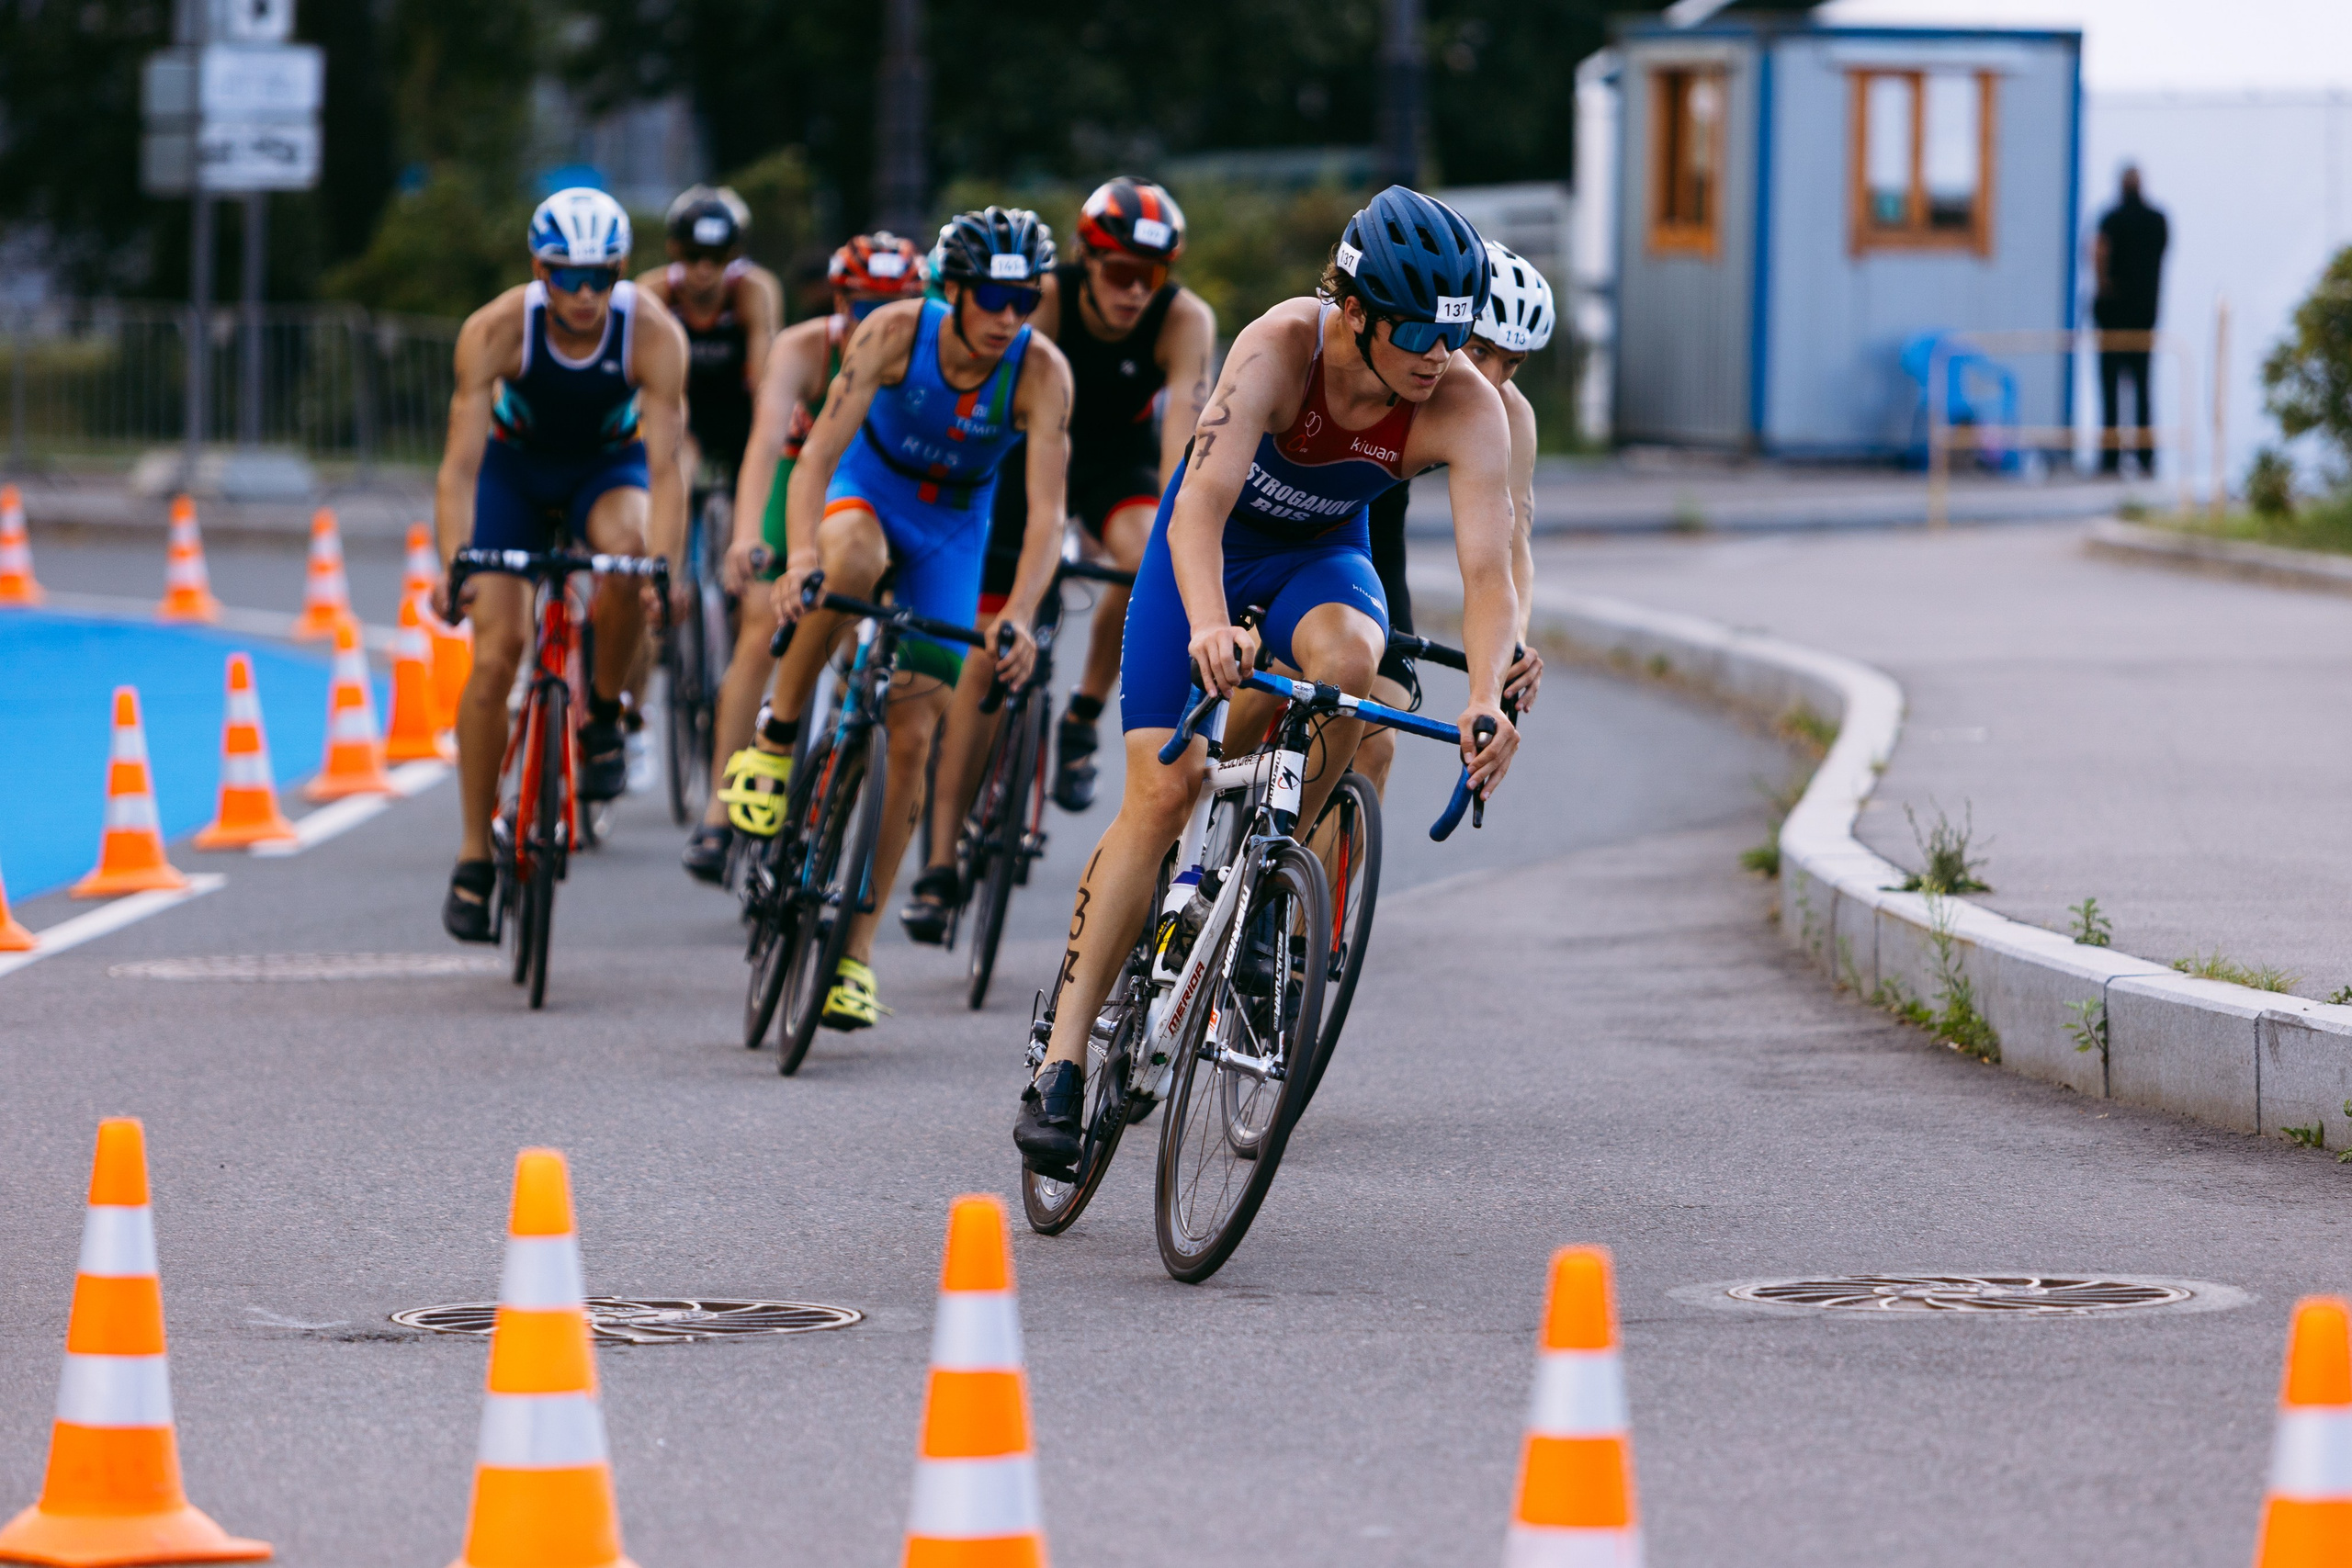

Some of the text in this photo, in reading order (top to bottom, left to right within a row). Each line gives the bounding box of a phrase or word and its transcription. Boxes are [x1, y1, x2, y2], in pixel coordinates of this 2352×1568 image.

[1340, 250, 1355, 268] 137
[1443, 302, 1468, 318] 137
[1246, 461, 1361, 516] STROGANOV
[1250, 497, 1311, 521] RUS
[1221, 884, 1251, 980] MERIDA
[1168, 960, 1205, 1036] MERIDA
[1273, 930, 1283, 1017] SCULTURA
